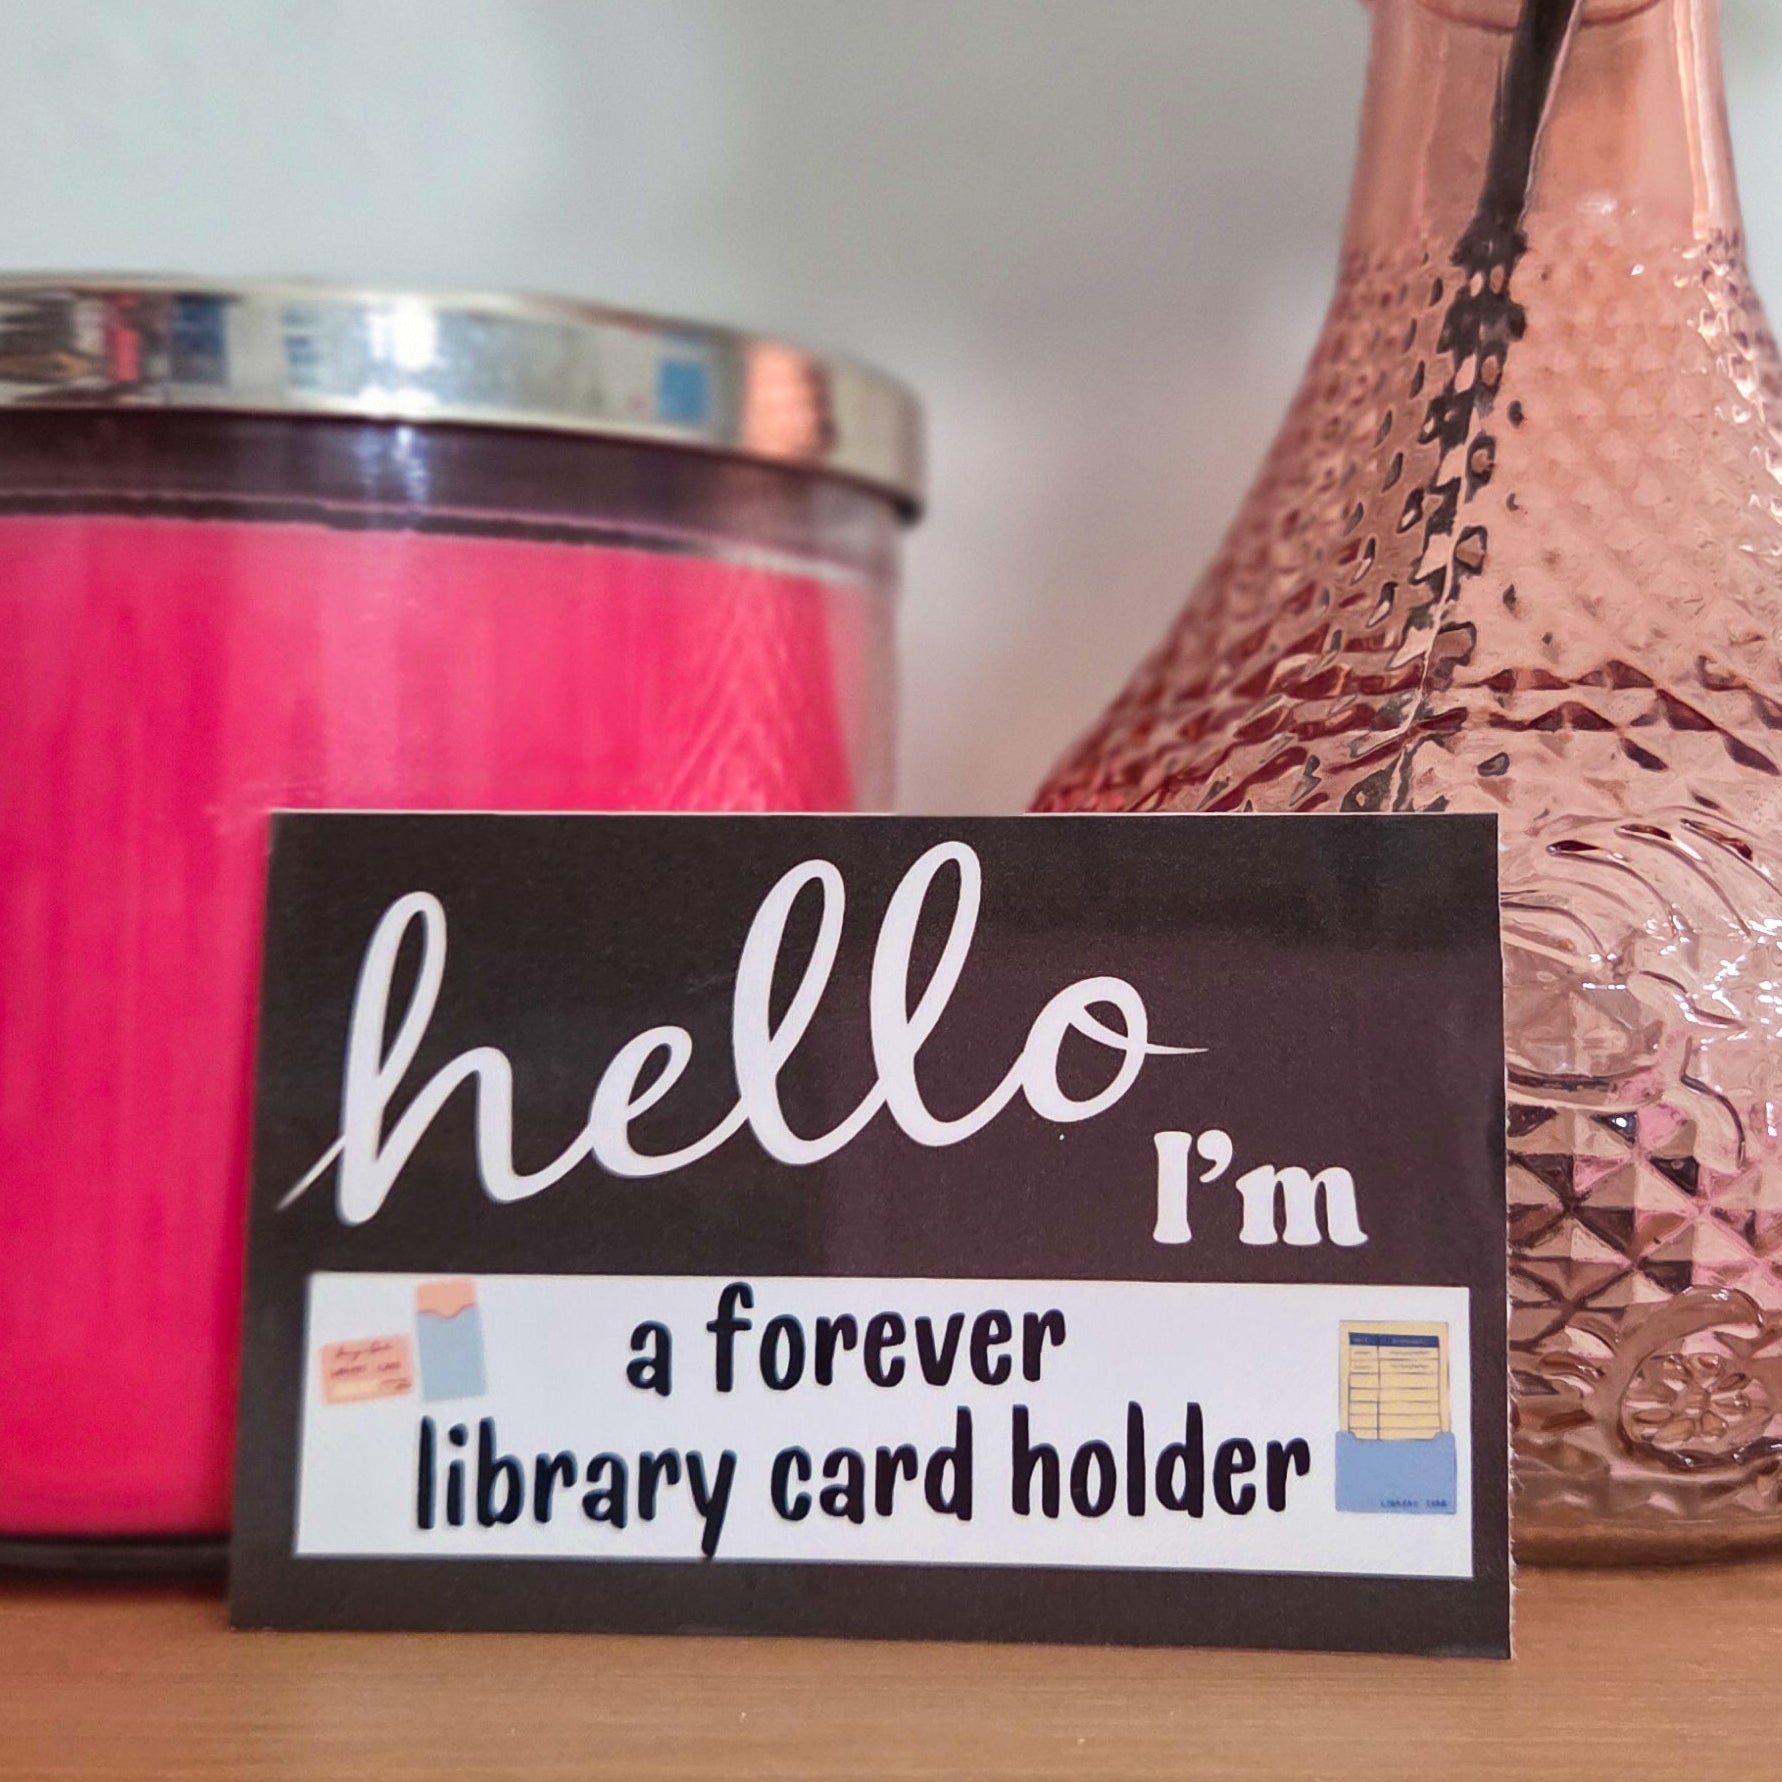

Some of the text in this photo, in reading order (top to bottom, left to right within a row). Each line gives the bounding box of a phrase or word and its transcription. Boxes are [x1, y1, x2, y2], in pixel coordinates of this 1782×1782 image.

[277, 840, 1208, 1226] hello
[1152, 1129, 1369, 1248] I'm
[626, 1281, 1066, 1397] a forever
[416, 1402, 1311, 1559] library card holder
